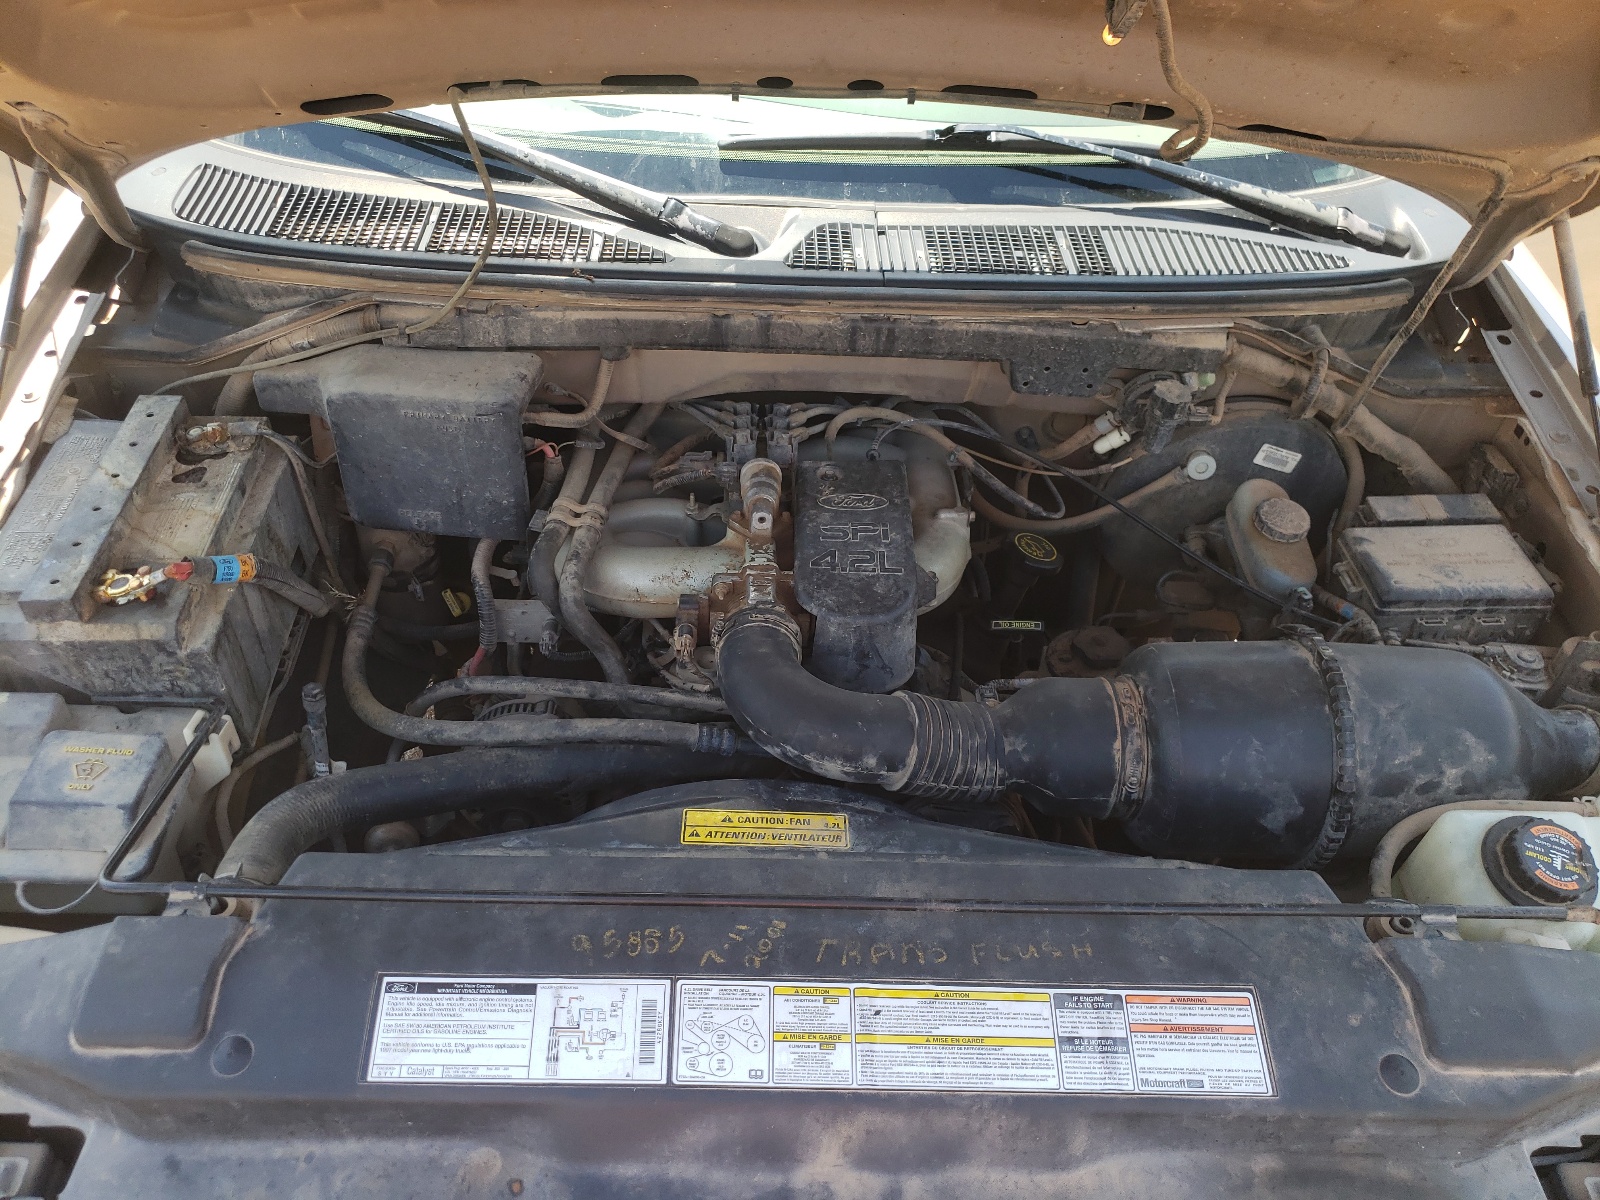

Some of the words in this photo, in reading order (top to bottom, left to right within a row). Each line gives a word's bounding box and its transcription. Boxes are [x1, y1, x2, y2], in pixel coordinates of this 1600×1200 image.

[831, 494, 876, 508] Ford
[809, 549, 905, 575] 4.2L
[64, 746, 105, 755] WASHER
[106, 748, 135, 756] FLUID
[68, 783, 94, 791] ONLY
[771, 832, 843, 843] VENTILATEUR
[1524, 850, 1552, 863] COOLANT
[407, 1066, 435, 1077] Catalyst
[1139, 1077, 1187, 1089] Motorcraft
